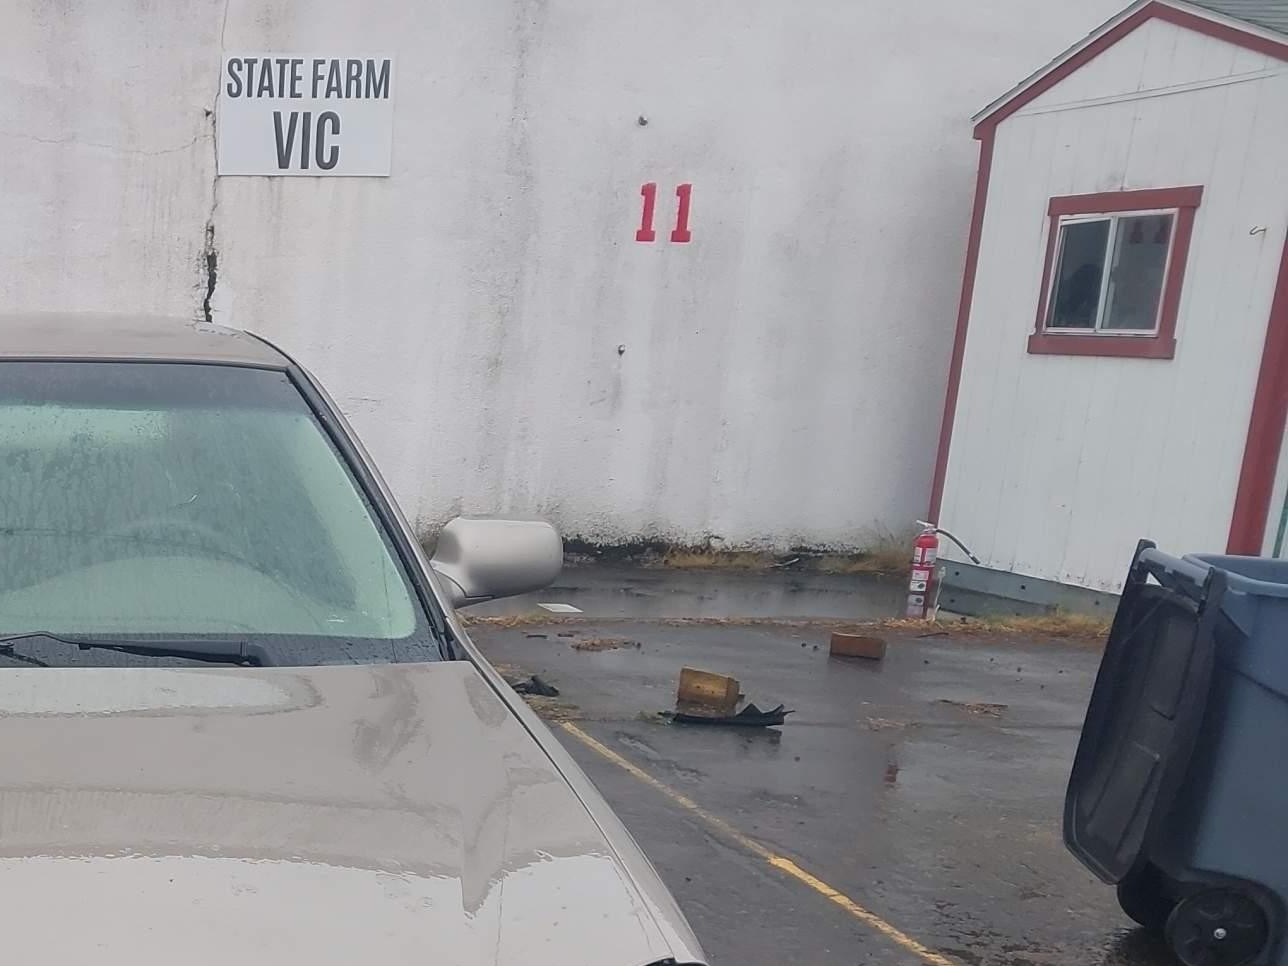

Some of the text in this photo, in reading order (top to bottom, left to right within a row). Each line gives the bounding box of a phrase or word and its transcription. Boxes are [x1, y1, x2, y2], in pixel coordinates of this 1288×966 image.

[227, 59, 390, 98] STATE FARM
[274, 112, 340, 170] VIC
[636, 184, 691, 244] 11
